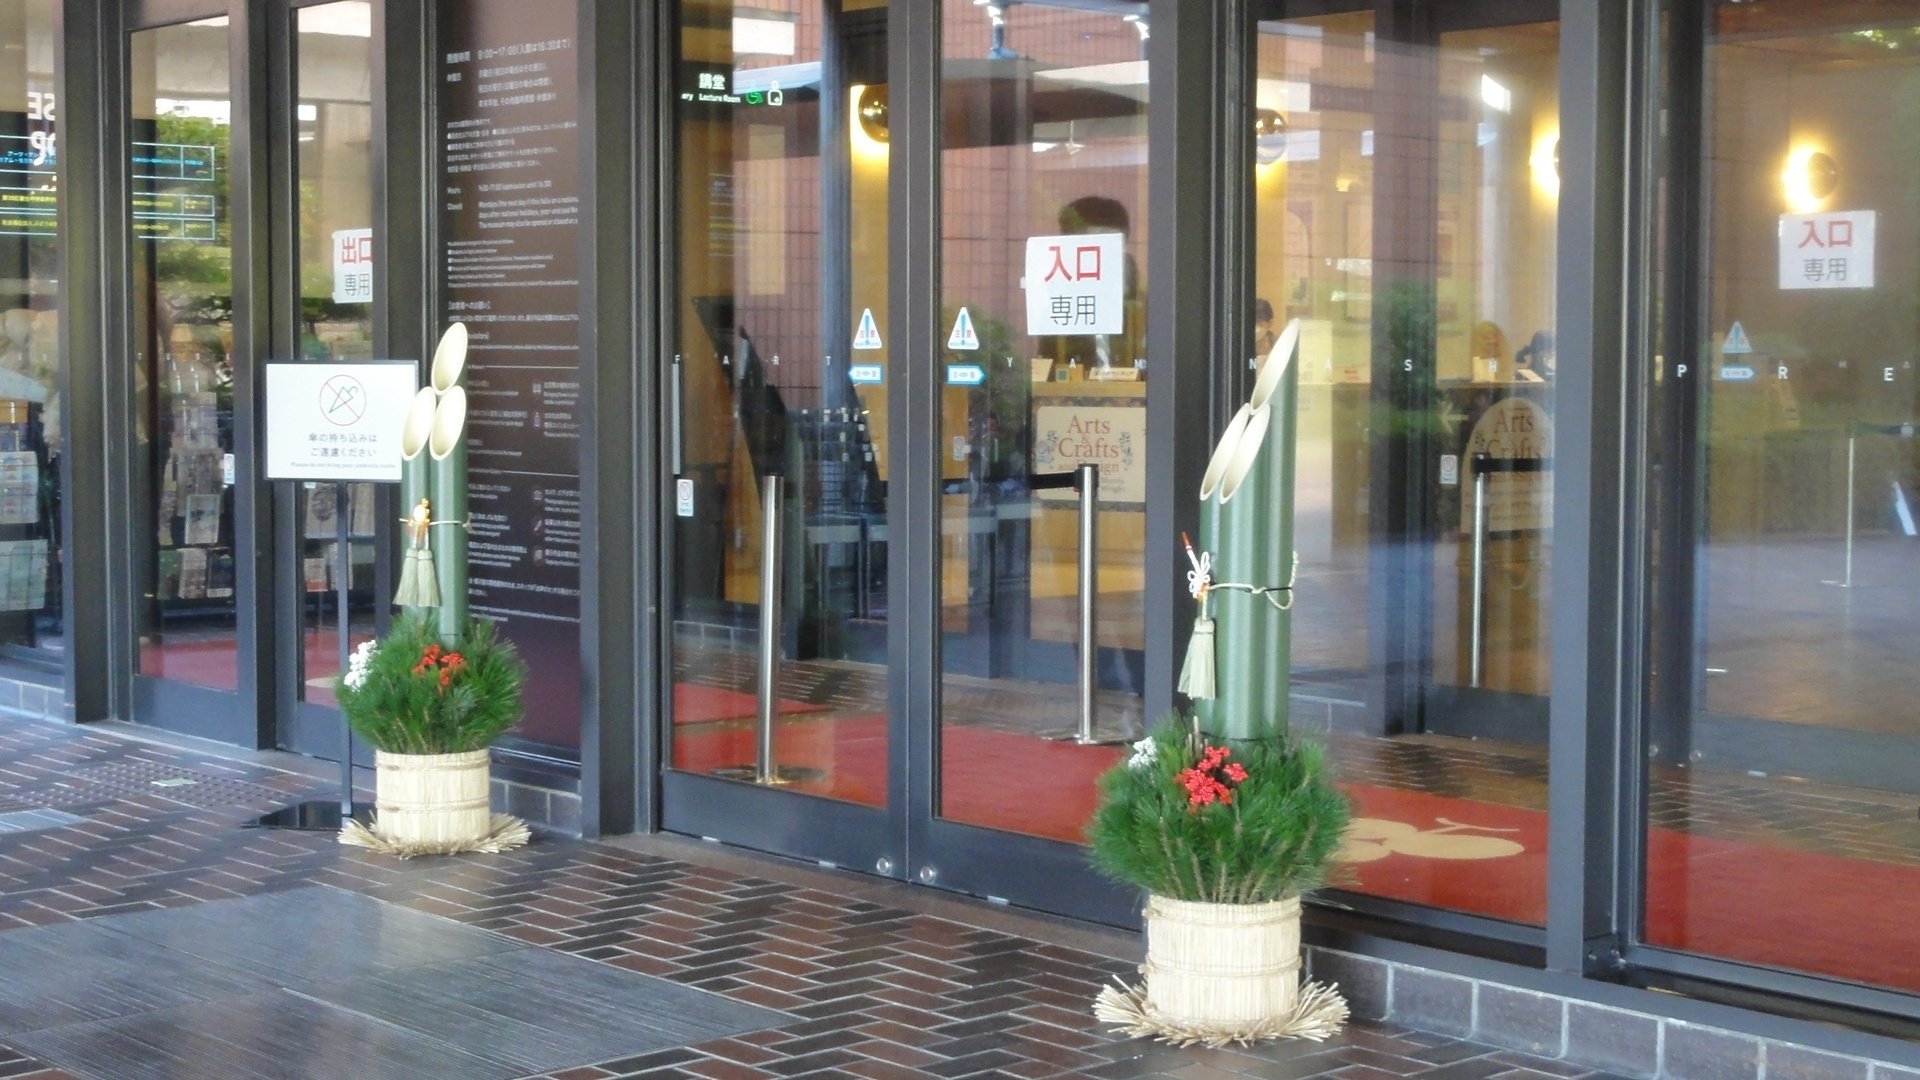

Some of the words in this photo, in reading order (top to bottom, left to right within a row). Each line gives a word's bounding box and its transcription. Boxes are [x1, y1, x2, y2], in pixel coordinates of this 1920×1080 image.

[1797, 220, 1853, 249] 入口
[341, 236, 373, 265] 出口
[1044, 246, 1101, 282] 入口
[1803, 257, 1847, 282] 専用
[344, 273, 370, 297] 専用
[1050, 294, 1096, 326] 専用
[1404, 359, 1413, 372] S
[1677, 364, 1688, 378] P
[1778, 366, 1788, 380] R
[1883, 367, 1895, 382] E
[1067, 414, 1111, 434] Arts
[1058, 437, 1120, 459] Crafts
